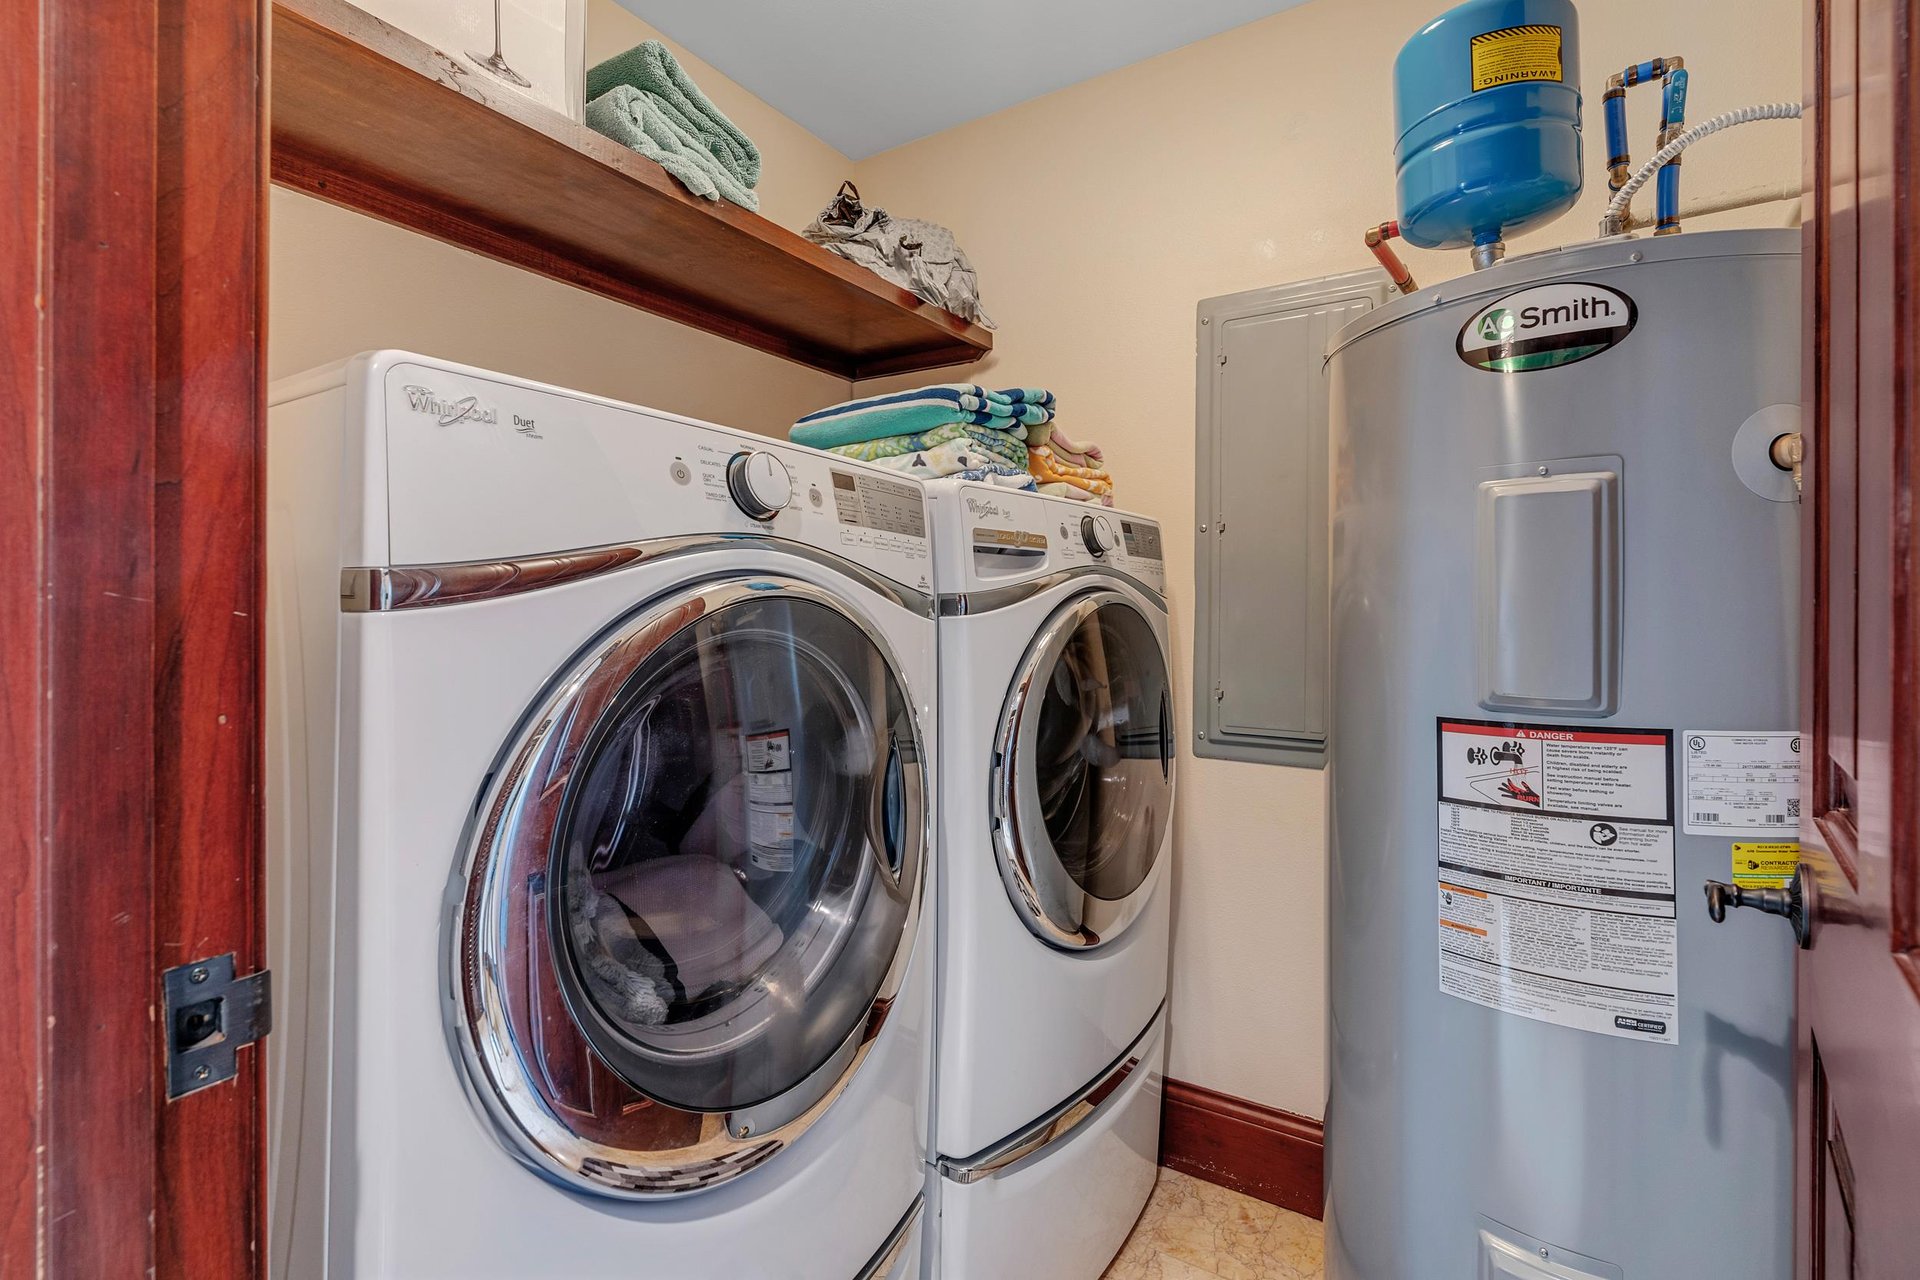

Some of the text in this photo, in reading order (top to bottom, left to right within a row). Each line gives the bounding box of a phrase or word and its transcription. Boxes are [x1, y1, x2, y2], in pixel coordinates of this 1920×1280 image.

[1479, 70, 1548, 86] WARNING:
[404, 385, 498, 426] Whirlpool
[513, 414, 535, 428] Duet
[966, 498, 998, 519] Whirlpool
[1529, 731, 1574, 740] DANGER
[1693, 739, 1702, 748] UL
[1504, 875, 1547, 887] IMPORTANT
[1552, 882, 1601, 894] IMPORTANTE
